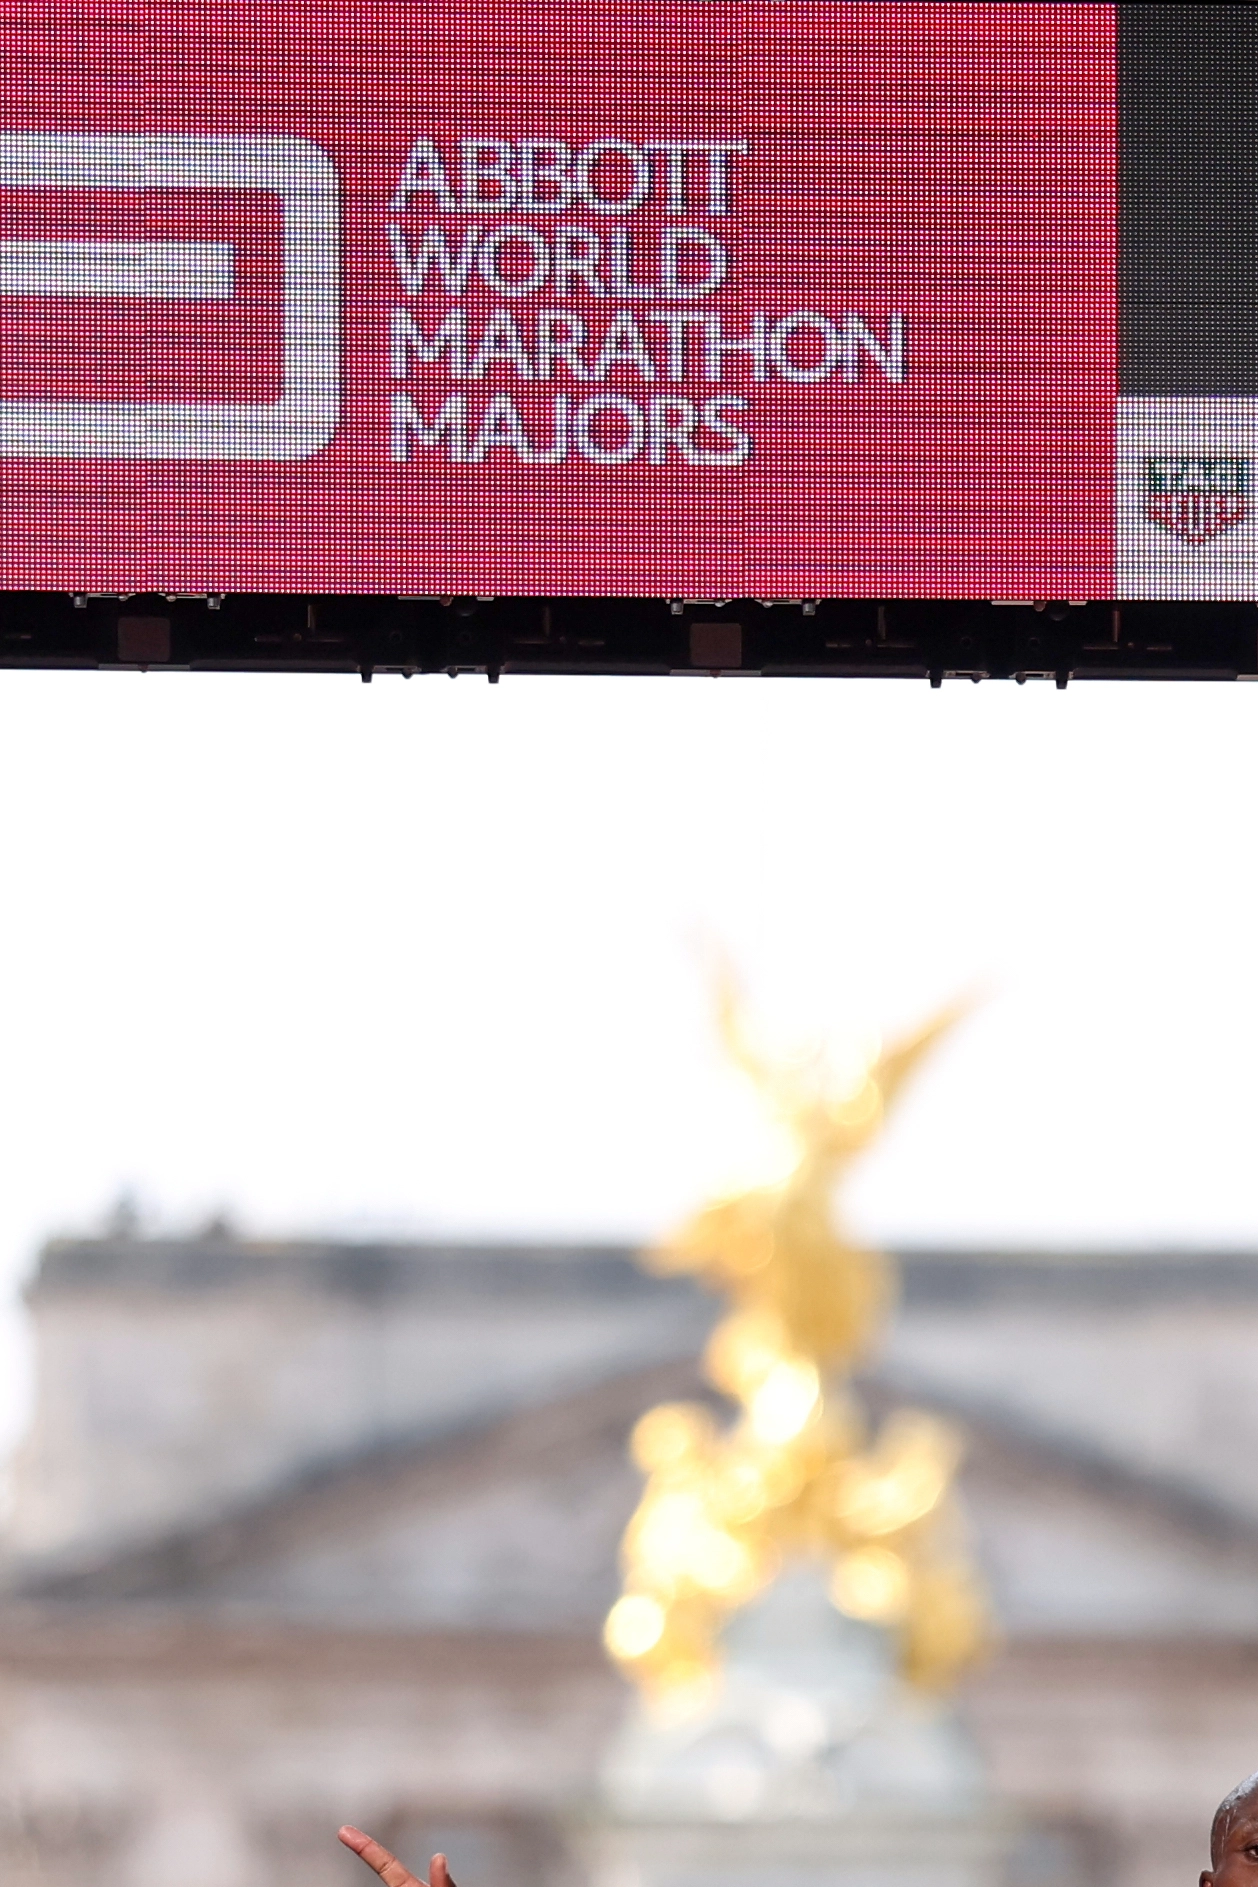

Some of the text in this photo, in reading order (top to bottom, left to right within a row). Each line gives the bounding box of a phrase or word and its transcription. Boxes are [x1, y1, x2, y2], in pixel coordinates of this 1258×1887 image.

[391, 138, 749, 214] ABBOTT
[388, 224, 731, 299] WORLD
[390, 308, 905, 384] MARATHON
[390, 391, 752, 467] MAJORS
